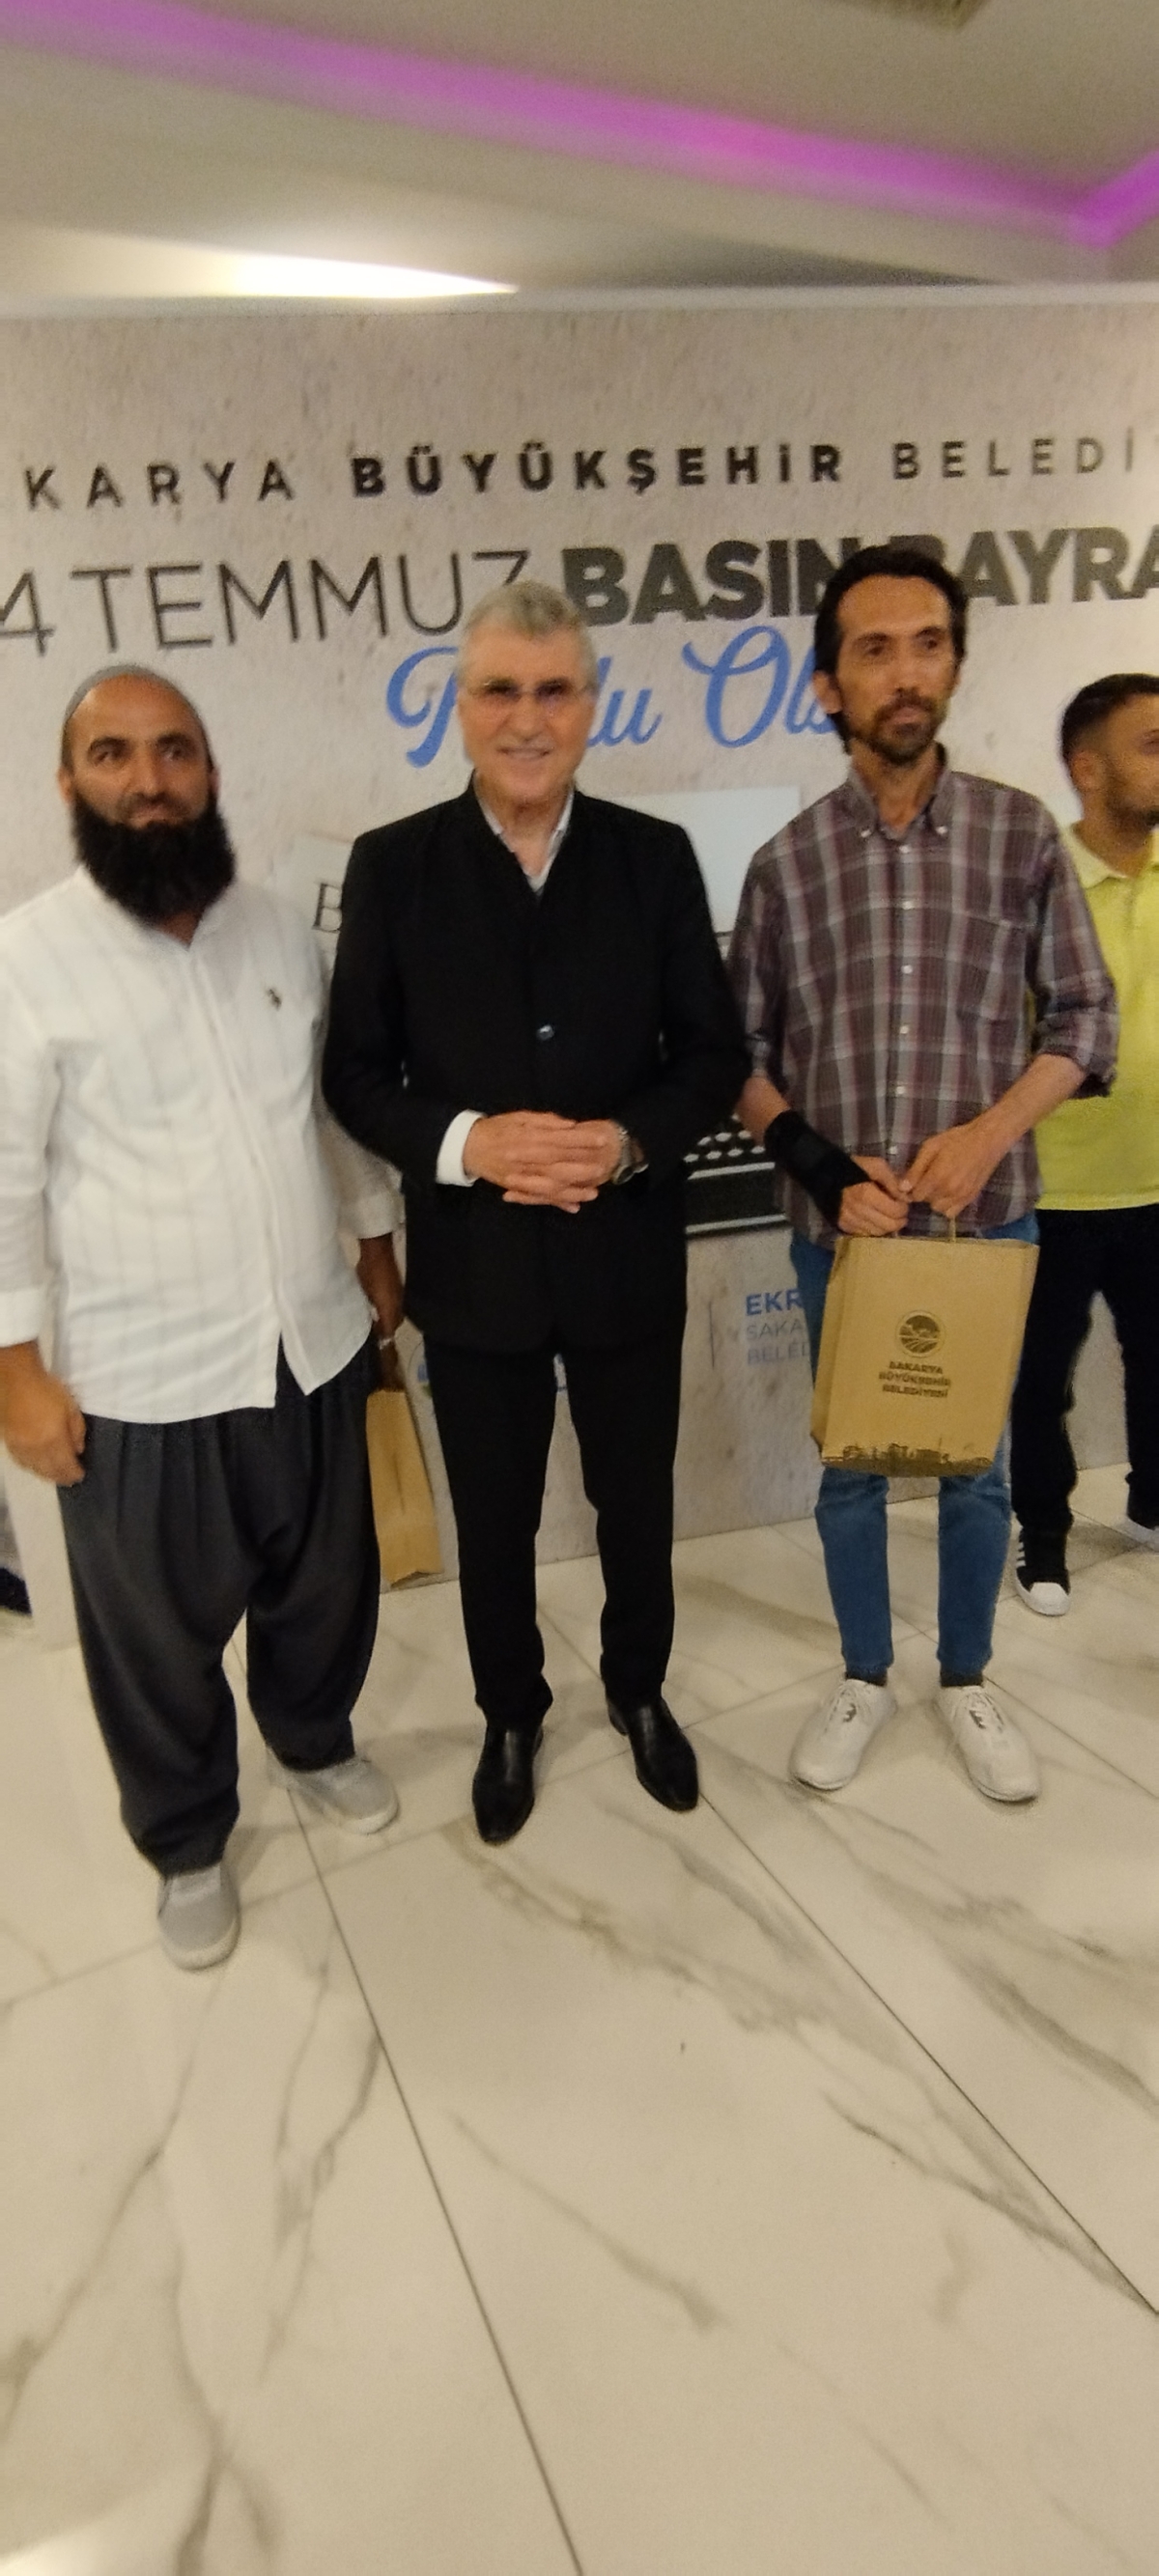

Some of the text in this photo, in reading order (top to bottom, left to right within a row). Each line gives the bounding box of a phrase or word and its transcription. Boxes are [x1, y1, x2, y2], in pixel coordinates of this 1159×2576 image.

[23, 426, 1159, 510] KARYA BÜYÜKŞEHİR BELEDİ
